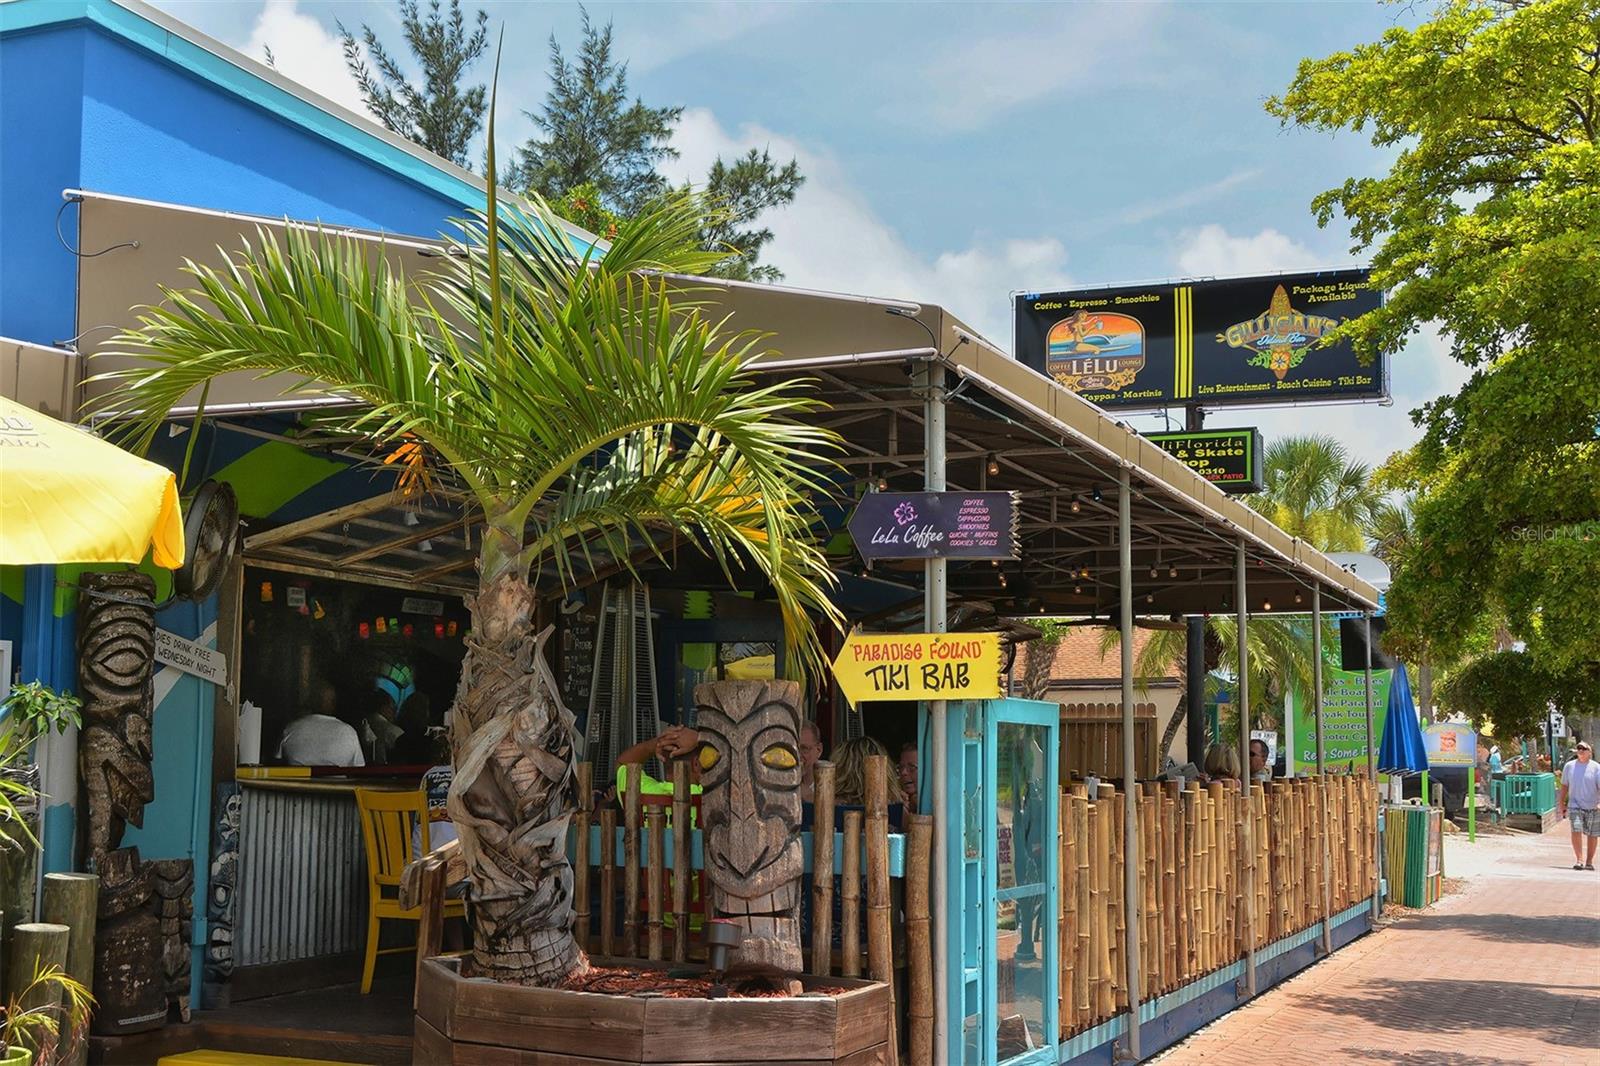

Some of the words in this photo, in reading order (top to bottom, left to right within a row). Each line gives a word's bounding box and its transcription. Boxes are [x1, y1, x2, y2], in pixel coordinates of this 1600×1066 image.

[1292, 284, 1336, 295] Package
[1338, 282, 1370, 292] Liquor
[1034, 301, 1063, 311] Coffee
[1069, 298, 1108, 309] Espresso
[1115, 294, 1160, 305] Smoothies
[1307, 292, 1357, 303] Available
[1256, 335, 1288, 346] Island
[1198, 385, 1214, 394] Live
[1215, 383, 1271, 393] Entertainment
[1276, 379, 1301, 389] Beach
[1302, 378, 1332, 388] Cuisine
[1338, 376, 1354, 386] Tiki
[1356, 376, 1371, 385] Bar
[1123, 389, 1162, 399] Martinis
[1161, 437, 1244, 450] liFlorida
[1176, 449, 1189, 458] &
[1195, 447, 1244, 458] Skate
[959, 507, 989, 515] ESPRESSO
[957, 523, 990, 531] SMOOTHIES
[871, 527, 899, 545] LeLu
[903, 524, 944, 549] Coffee
[156, 631, 171, 646] DIES
[173, 639, 192, 654] DRINK
[194, 647, 211, 662] FREE
[158, 646, 194, 668] WEDNESDAY
[196, 662, 217, 678] NIGHT
[864, 663, 911, 692] TIKI
[920, 662, 971, 691] BAR
[1341, 688, 1378, 696] Boars
[1303, 750, 1327, 761] Ret
[1330, 747, 1359, 759] Some
